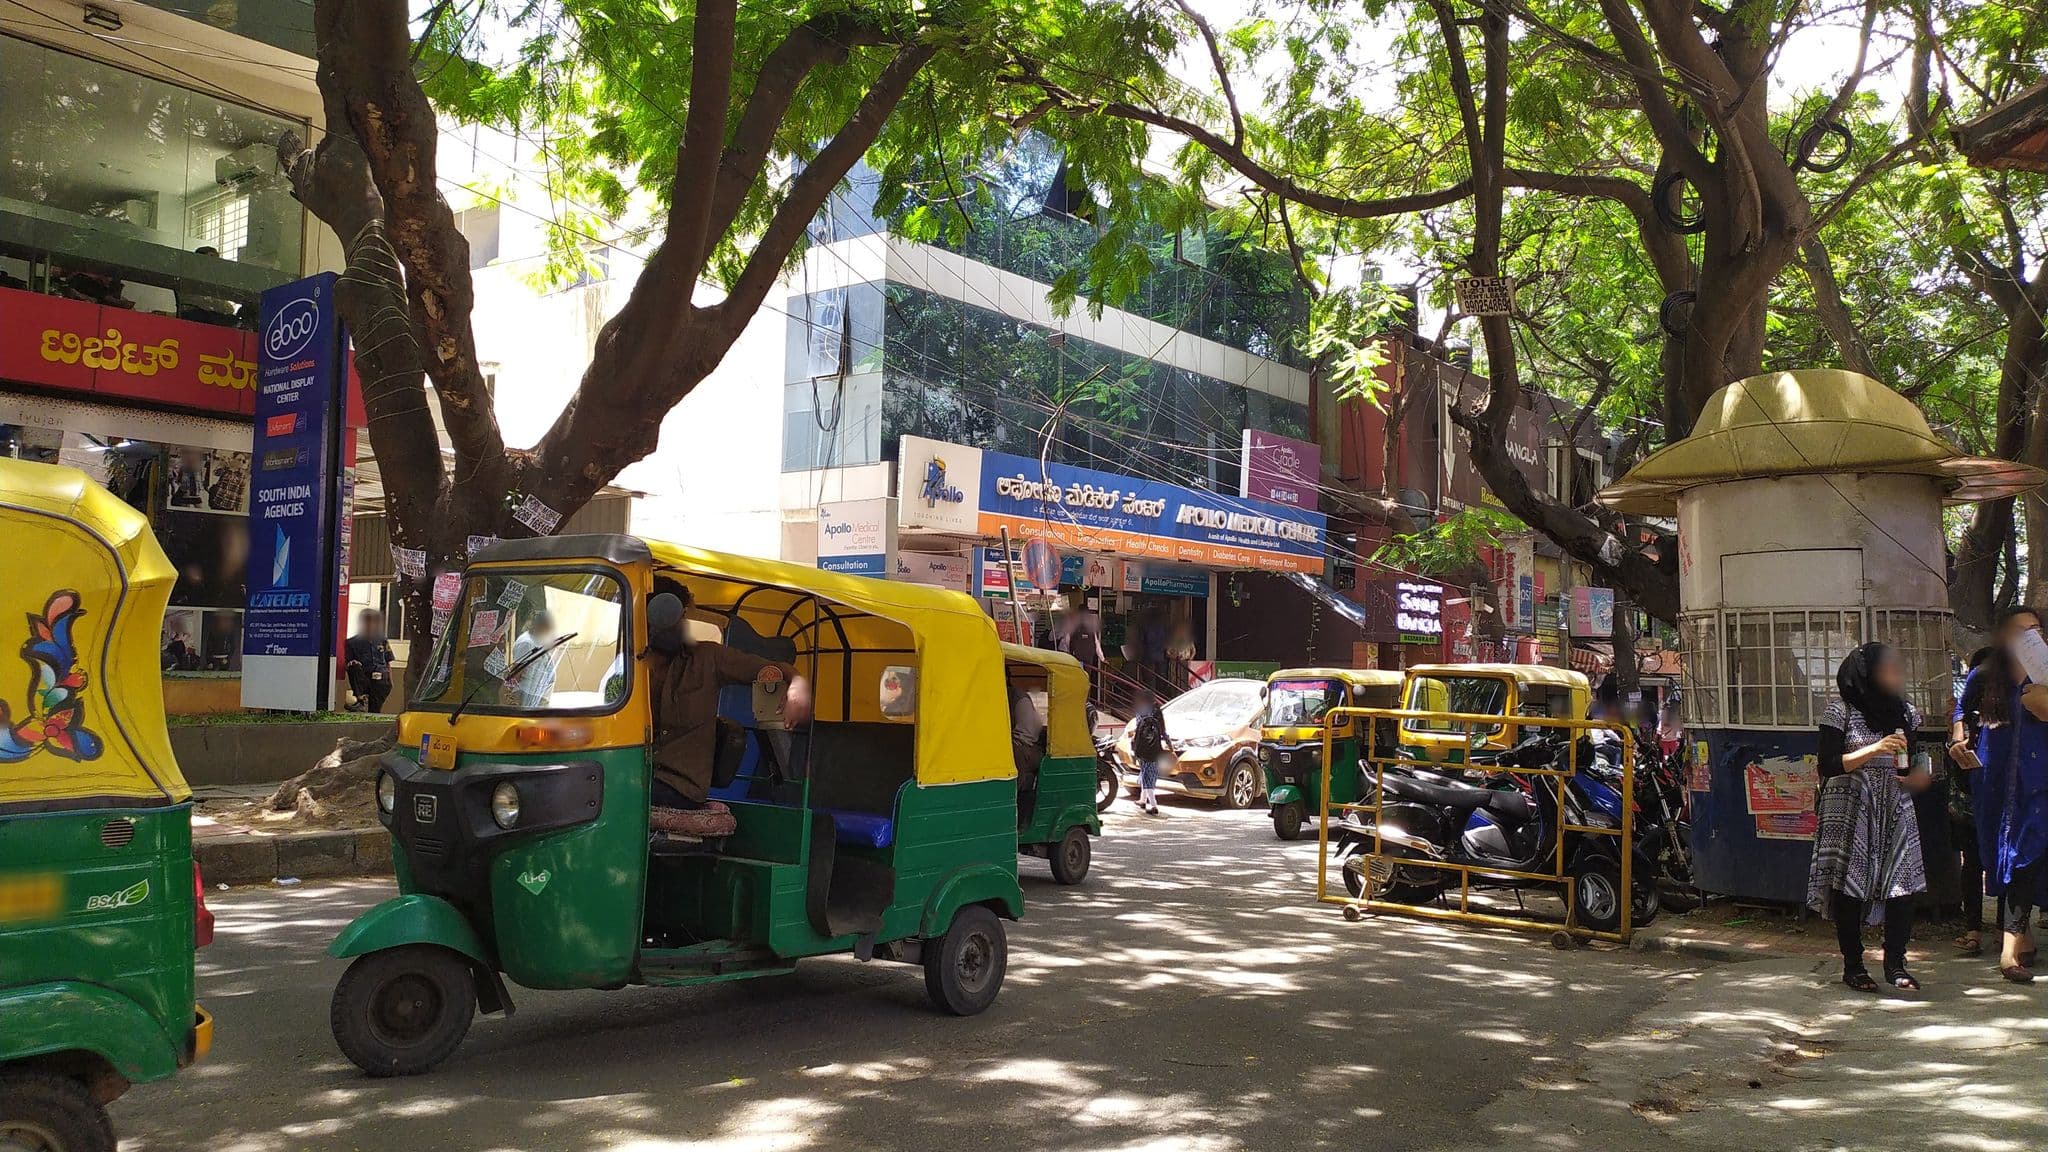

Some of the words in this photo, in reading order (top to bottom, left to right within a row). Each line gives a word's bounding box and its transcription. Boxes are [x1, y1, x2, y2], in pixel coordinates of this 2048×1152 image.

[1460, 276, 1507, 289] TOLET
[263, 380, 290, 394] NATIONAL
[291, 376, 315, 389] DISPLAY
[276, 391, 300, 404] CENTER
[259, 487, 286, 502] SOUTH
[288, 485, 311, 500] INDIA
[264, 503, 304, 519] AGENCIES
[1176, 503, 1227, 530] APOLLO
[1227, 511, 1279, 538] MEDICAL
[1279, 521, 1319, 543] CENTRE
[1019, 524, 1065, 540] Consultation
[1077, 531, 1116, 547] Diagnostics
[1126, 538, 1148, 550] Health
[1149, 542, 1170, 554] Checks
[1178, 545, 1205, 558] Dentistry
[1213, 550, 1236, 562] Diabetes
[1237, 554, 1251, 563] Care
[1259, 556, 1283, 568] Treatment
[1284, 558, 1298, 569] Room
[823, 560, 869, 571] Consultation
[898, 566, 911, 576] pollo
[929, 562, 946, 573] Apollo
[434, 608, 449, 619] WAN
[273, 645, 288, 655] Floor
[88, 891, 121, 909] BS4
